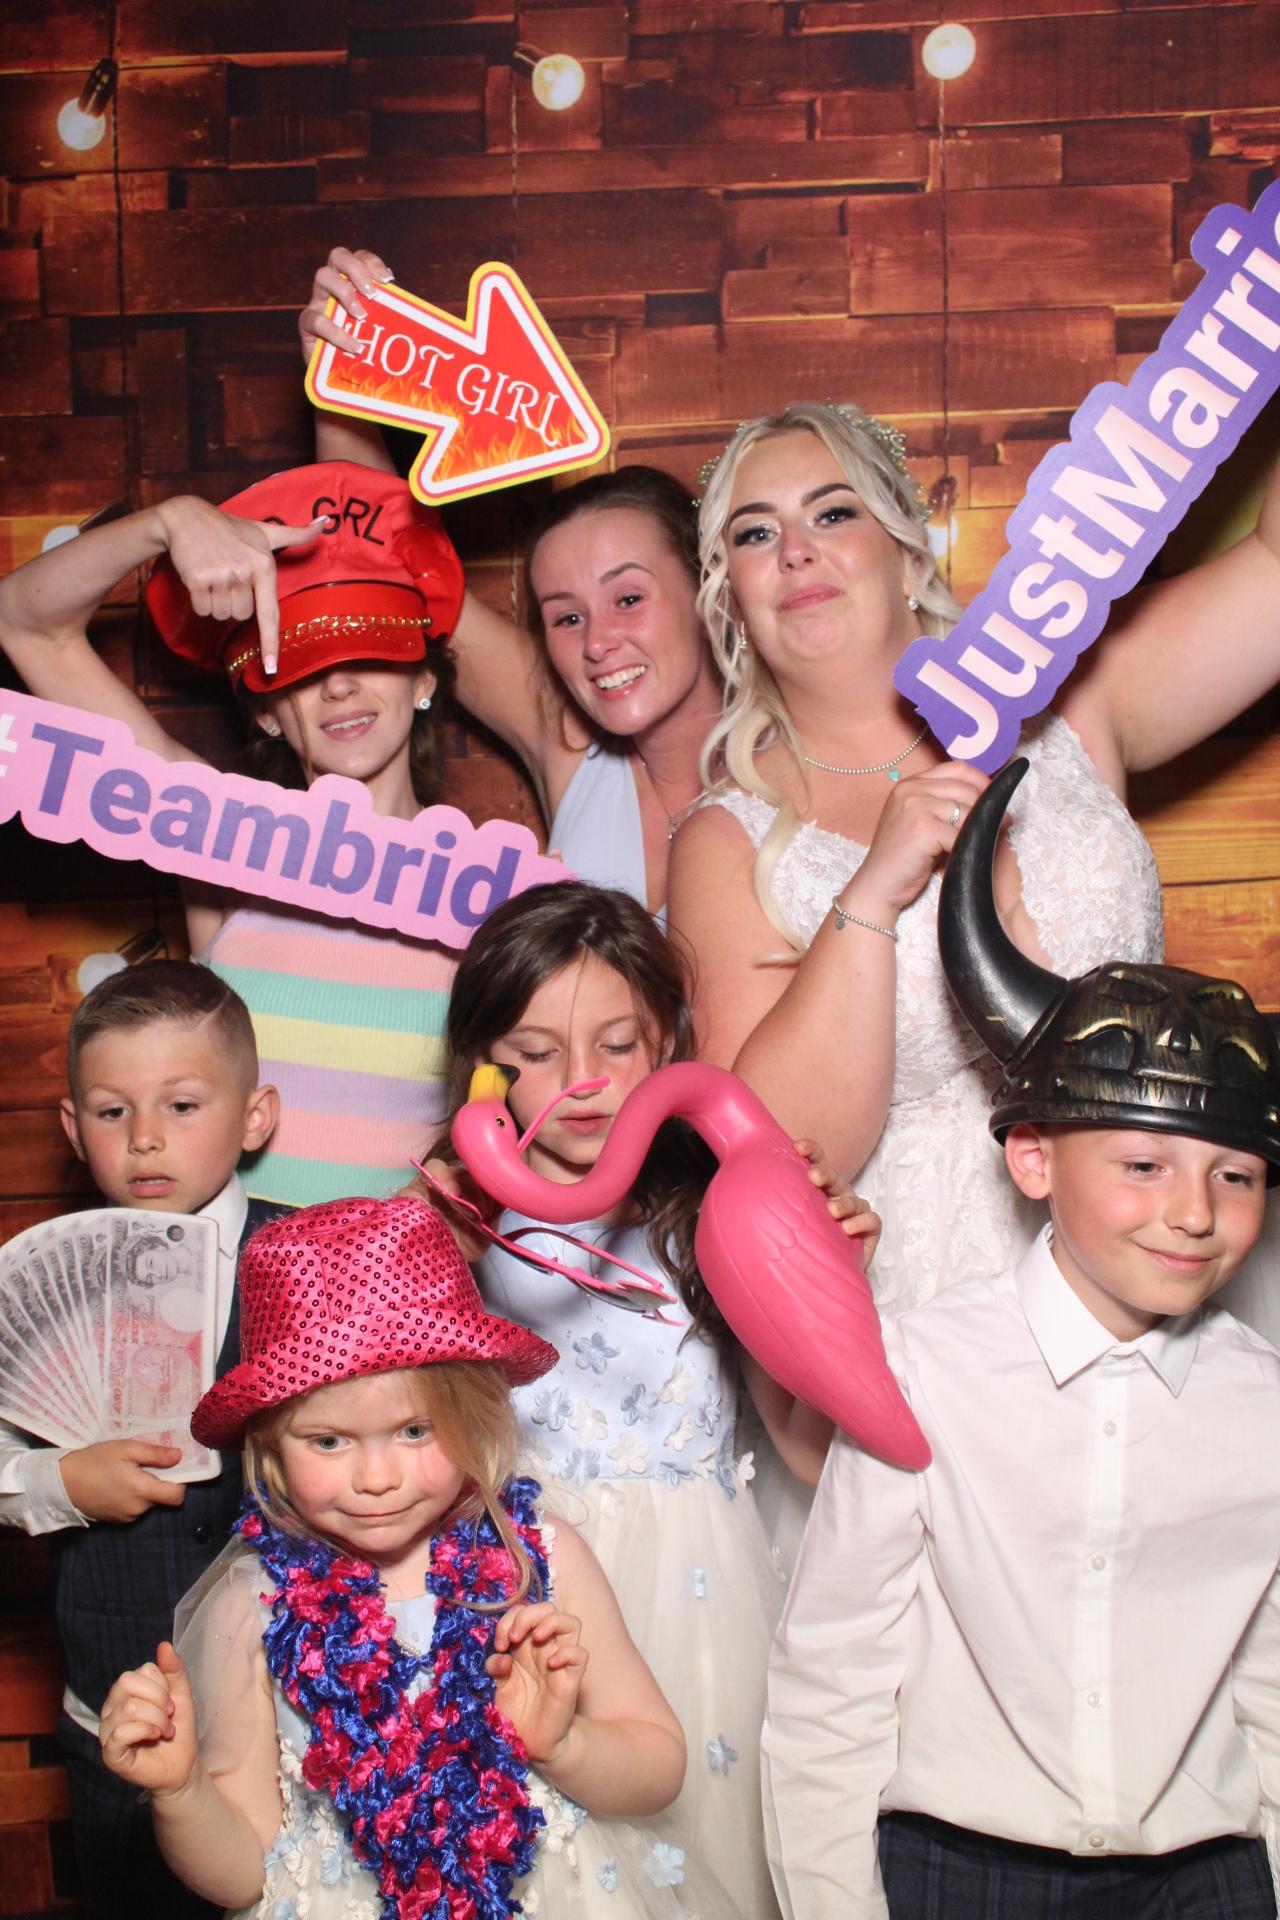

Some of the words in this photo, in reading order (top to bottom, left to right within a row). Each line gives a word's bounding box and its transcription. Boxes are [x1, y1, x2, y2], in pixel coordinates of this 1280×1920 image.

[342, 319, 454, 390] HOT
[456, 363, 559, 447] GIRL
[312, 496, 385, 546] GRL
[916, 208, 1280, 760] JustMarri
[0, 712, 553, 928] Teambrid
